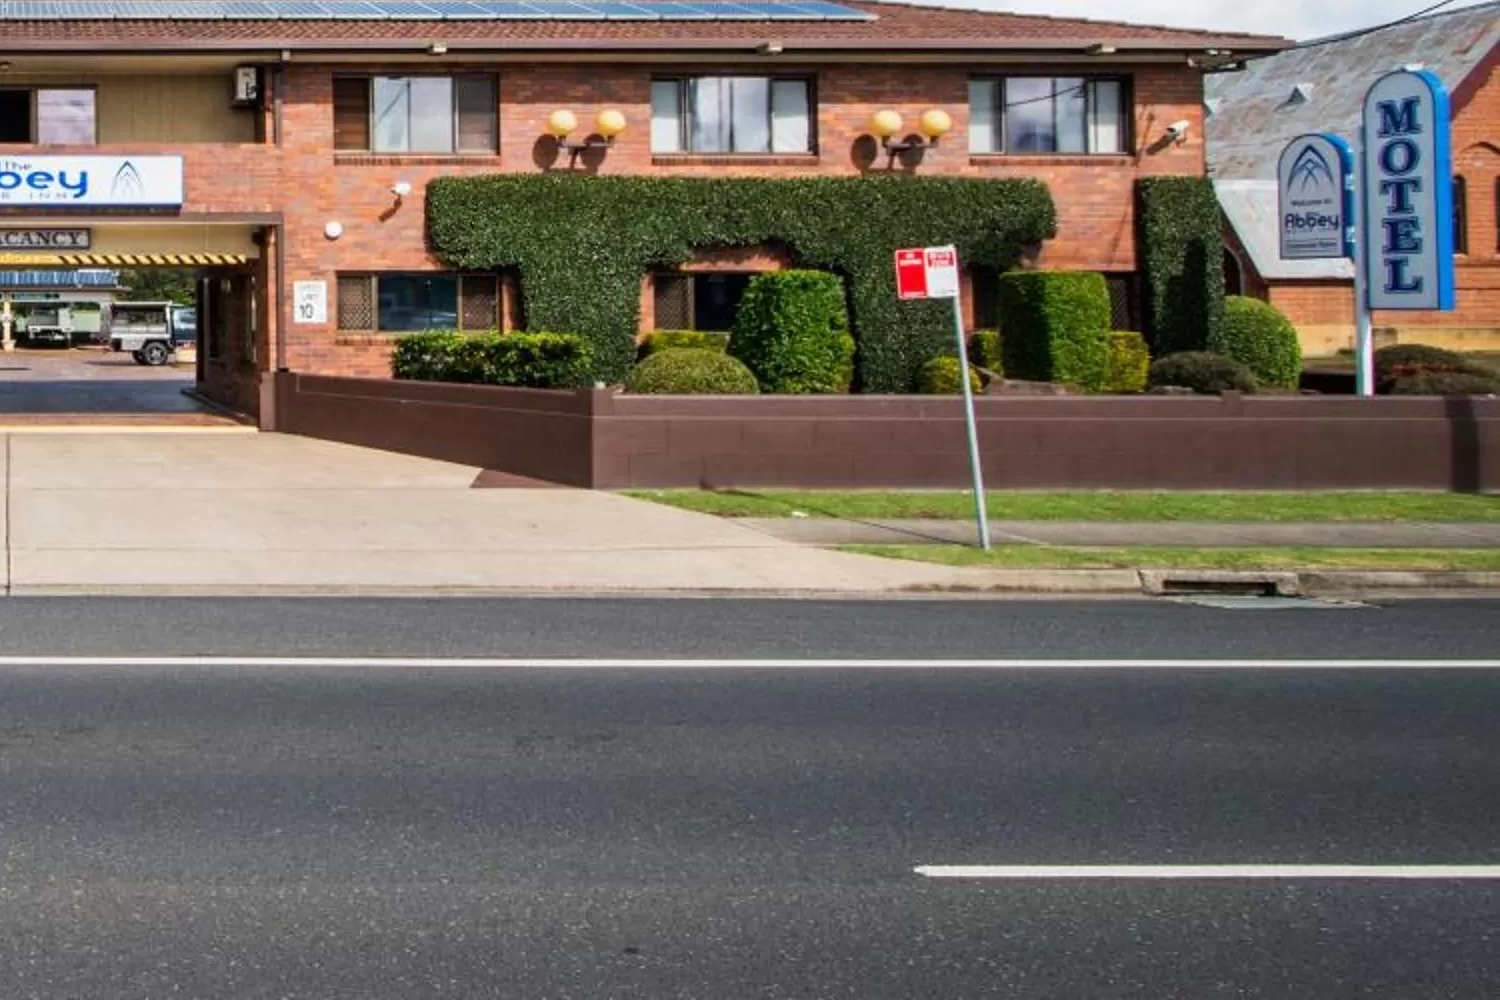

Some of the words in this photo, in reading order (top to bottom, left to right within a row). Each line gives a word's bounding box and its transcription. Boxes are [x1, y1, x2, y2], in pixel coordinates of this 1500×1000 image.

[1376, 96, 1423, 294] MOTEL
[1284, 212, 1339, 230] Abbey
[300, 303, 314, 319] 10
